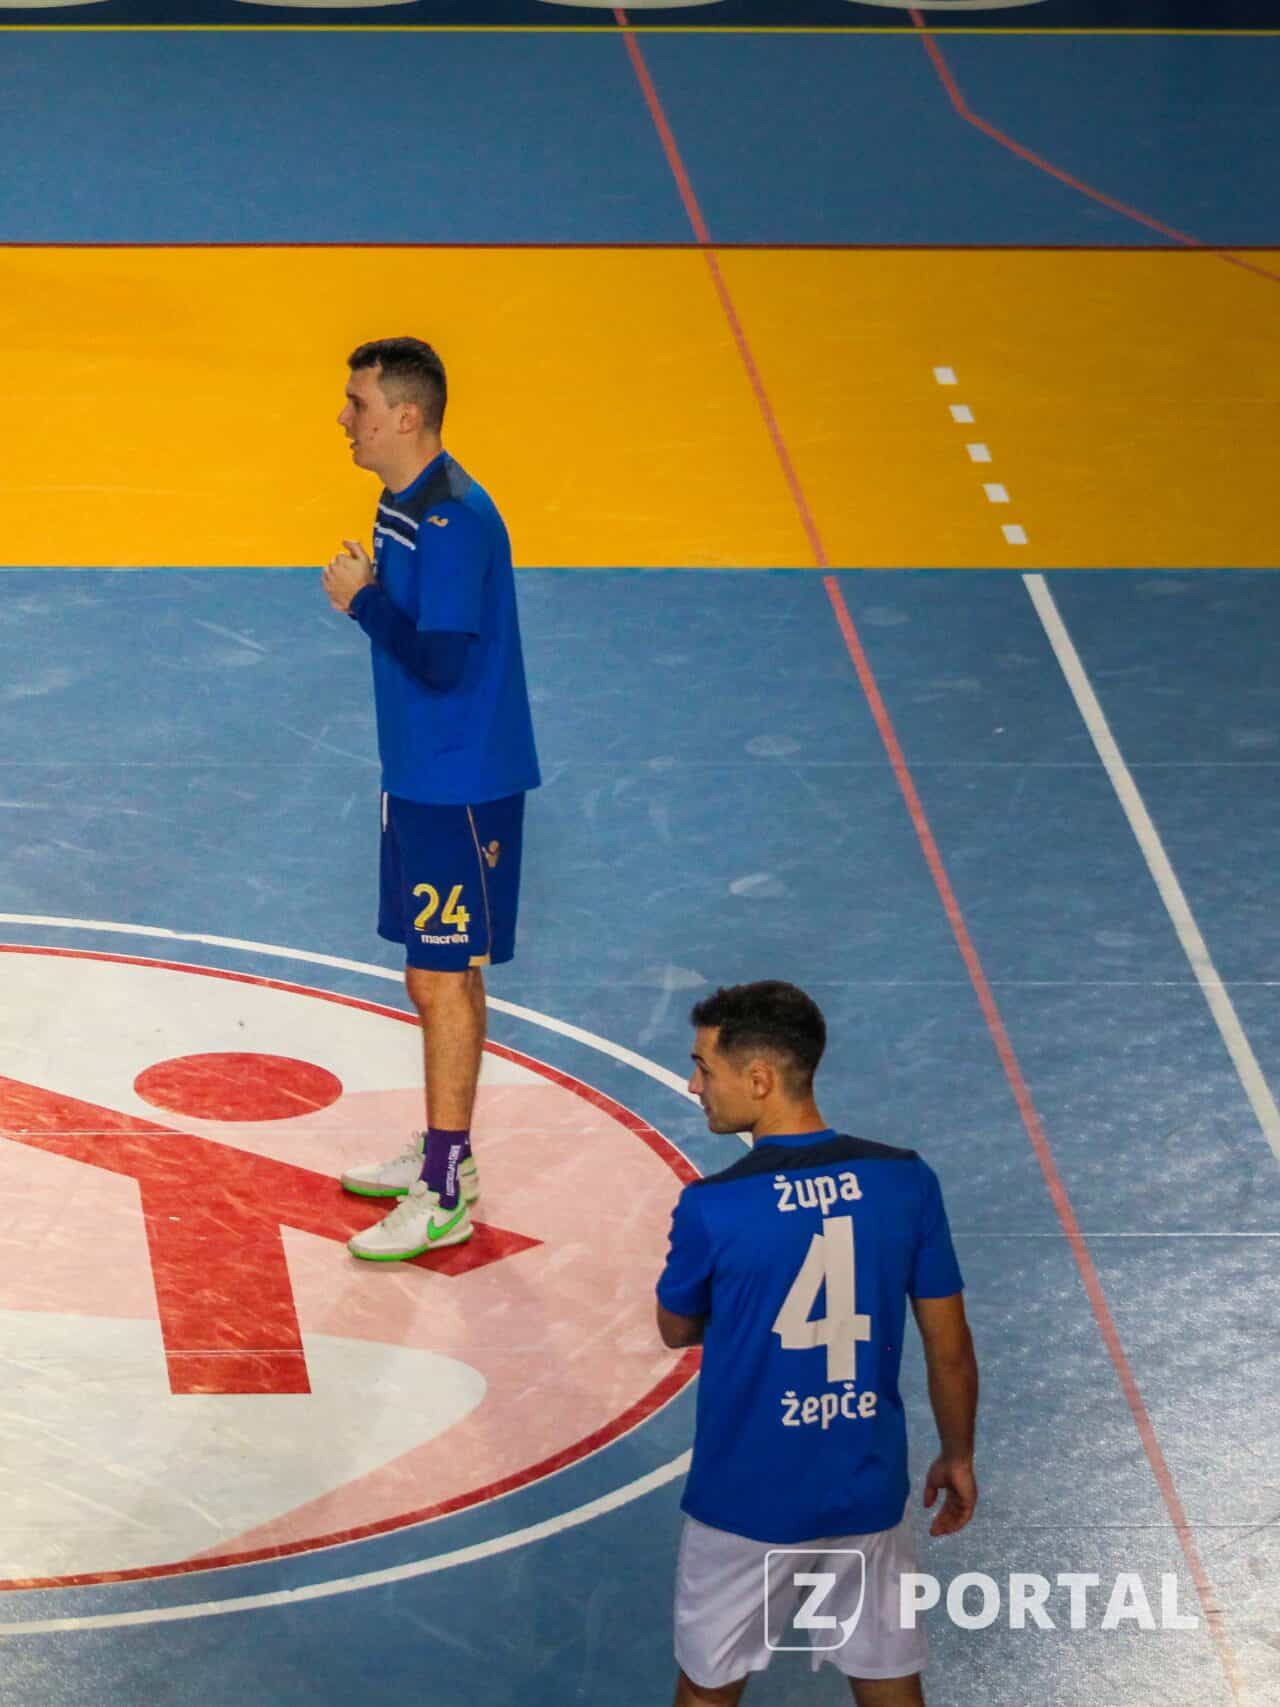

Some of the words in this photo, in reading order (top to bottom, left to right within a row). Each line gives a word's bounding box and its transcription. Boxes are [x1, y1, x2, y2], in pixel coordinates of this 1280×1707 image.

[412, 883, 470, 932] 24
[421, 933, 469, 945] macron
[771, 1215, 871, 1383] 4
